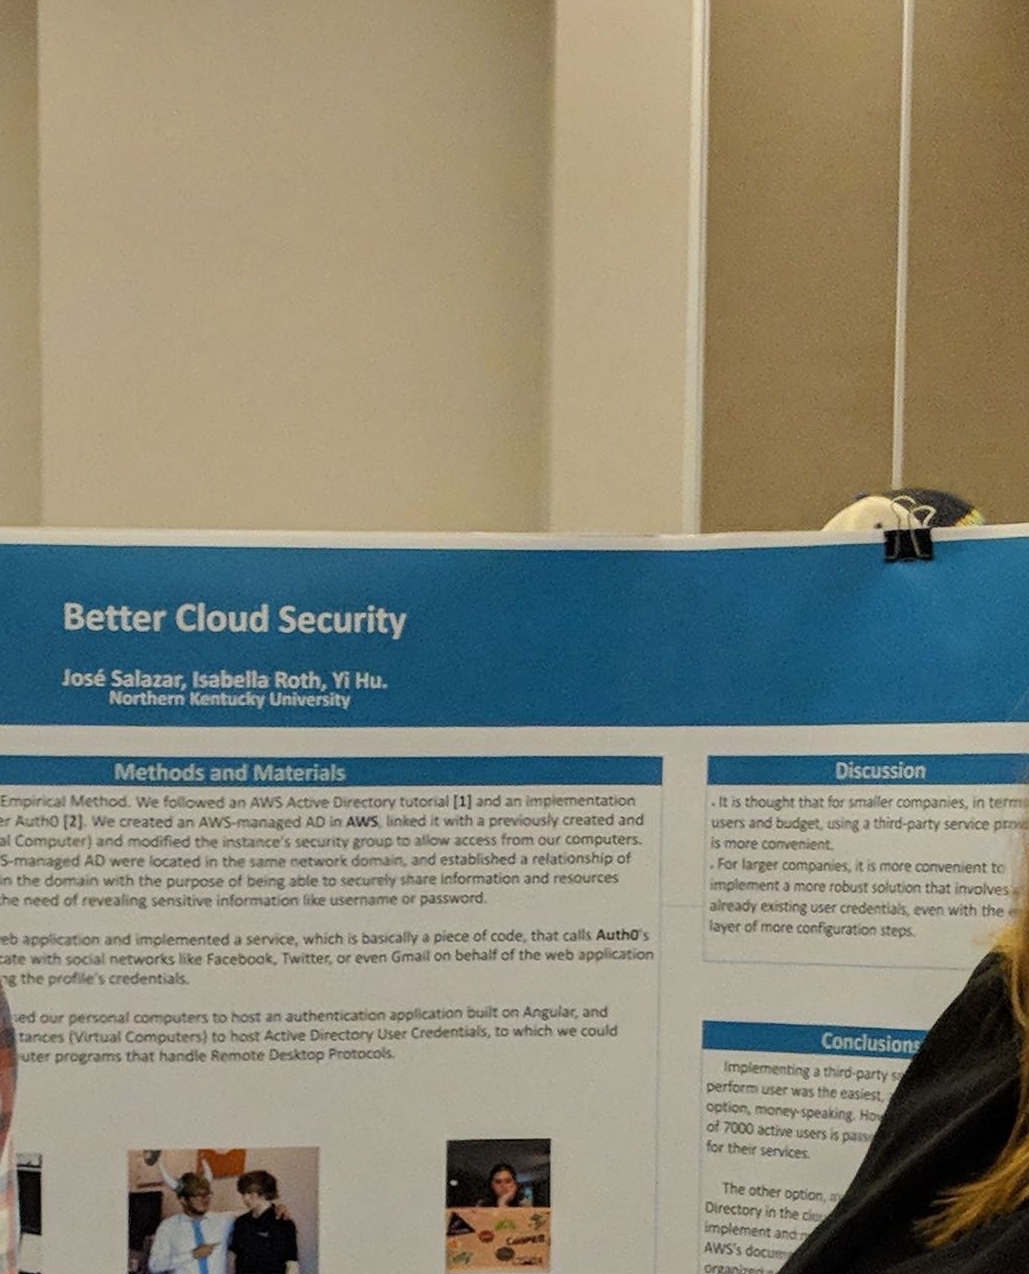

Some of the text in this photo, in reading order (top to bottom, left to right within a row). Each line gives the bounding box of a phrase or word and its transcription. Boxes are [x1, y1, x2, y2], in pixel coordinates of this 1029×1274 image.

[63, 603, 407, 639] Better Cloud Security
[62, 668, 387, 692] José Salazar, Isabella Roth, Yi Hu.
[109, 691, 351, 710] Northern Kentucky University
[114, 762, 346, 781] Methods and Materials
[835, 762, 926, 780] Discussion
[63, 815, 85, 831] [2].
[92, 815, 115, 828] We
[120, 815, 173, 828] created
[177, 819, 194, 828] an
[199, 815, 301, 831] AWS-managed
[306, 815, 325, 828] AD
[330, 816, 342, 828] in
[387, 814, 426, 828] linked
[430, 815, 439, 827] it
[444, 814, 473, 827] with
[477, 818, 484, 827] a
[489, 814, 559, 830] previously
[562, 813, 614, 827] created
[618, 813, 644, 826] and
[712, 820, 745, 829] users
[749, 816, 772, 829] and
[827, 818, 859, 832] using
[863, 820, 870, 830] a
[874, 817, 940, 833] third-party
[944, 818, 990, 830] service
[718, 858, 738, 871] For
[742, 858, 778, 874] larger
[782, 860, 851, 875] companies,
[855, 860, 863, 873] it
[867, 861, 876, 873] is
[880, 863, 912, 873] more
[915, 861, 987, 874] convenient
[710, 899, 757, 916] already
[760, 901, 807, 917] existing
[811, 905, 837, 915] user
[914, 906, 944, 916] even
[948, 903, 977, 917] with
[982, 904, 1004, 917] the
[40, 1005, 608, 1026] our personal computers to host an authentication application built on Angular, and
[821, 1032, 920, 1054] Conclusions
[706, 1120, 720, 1134] of
[724, 1121, 754, 1136] 7000
[757, 1124, 793, 1138] active
[796, 1129, 827, 1140] users
[830, 1128, 839, 1140] is
[723, 1182, 745, 1197] The
[749, 1184, 781, 1199] other
